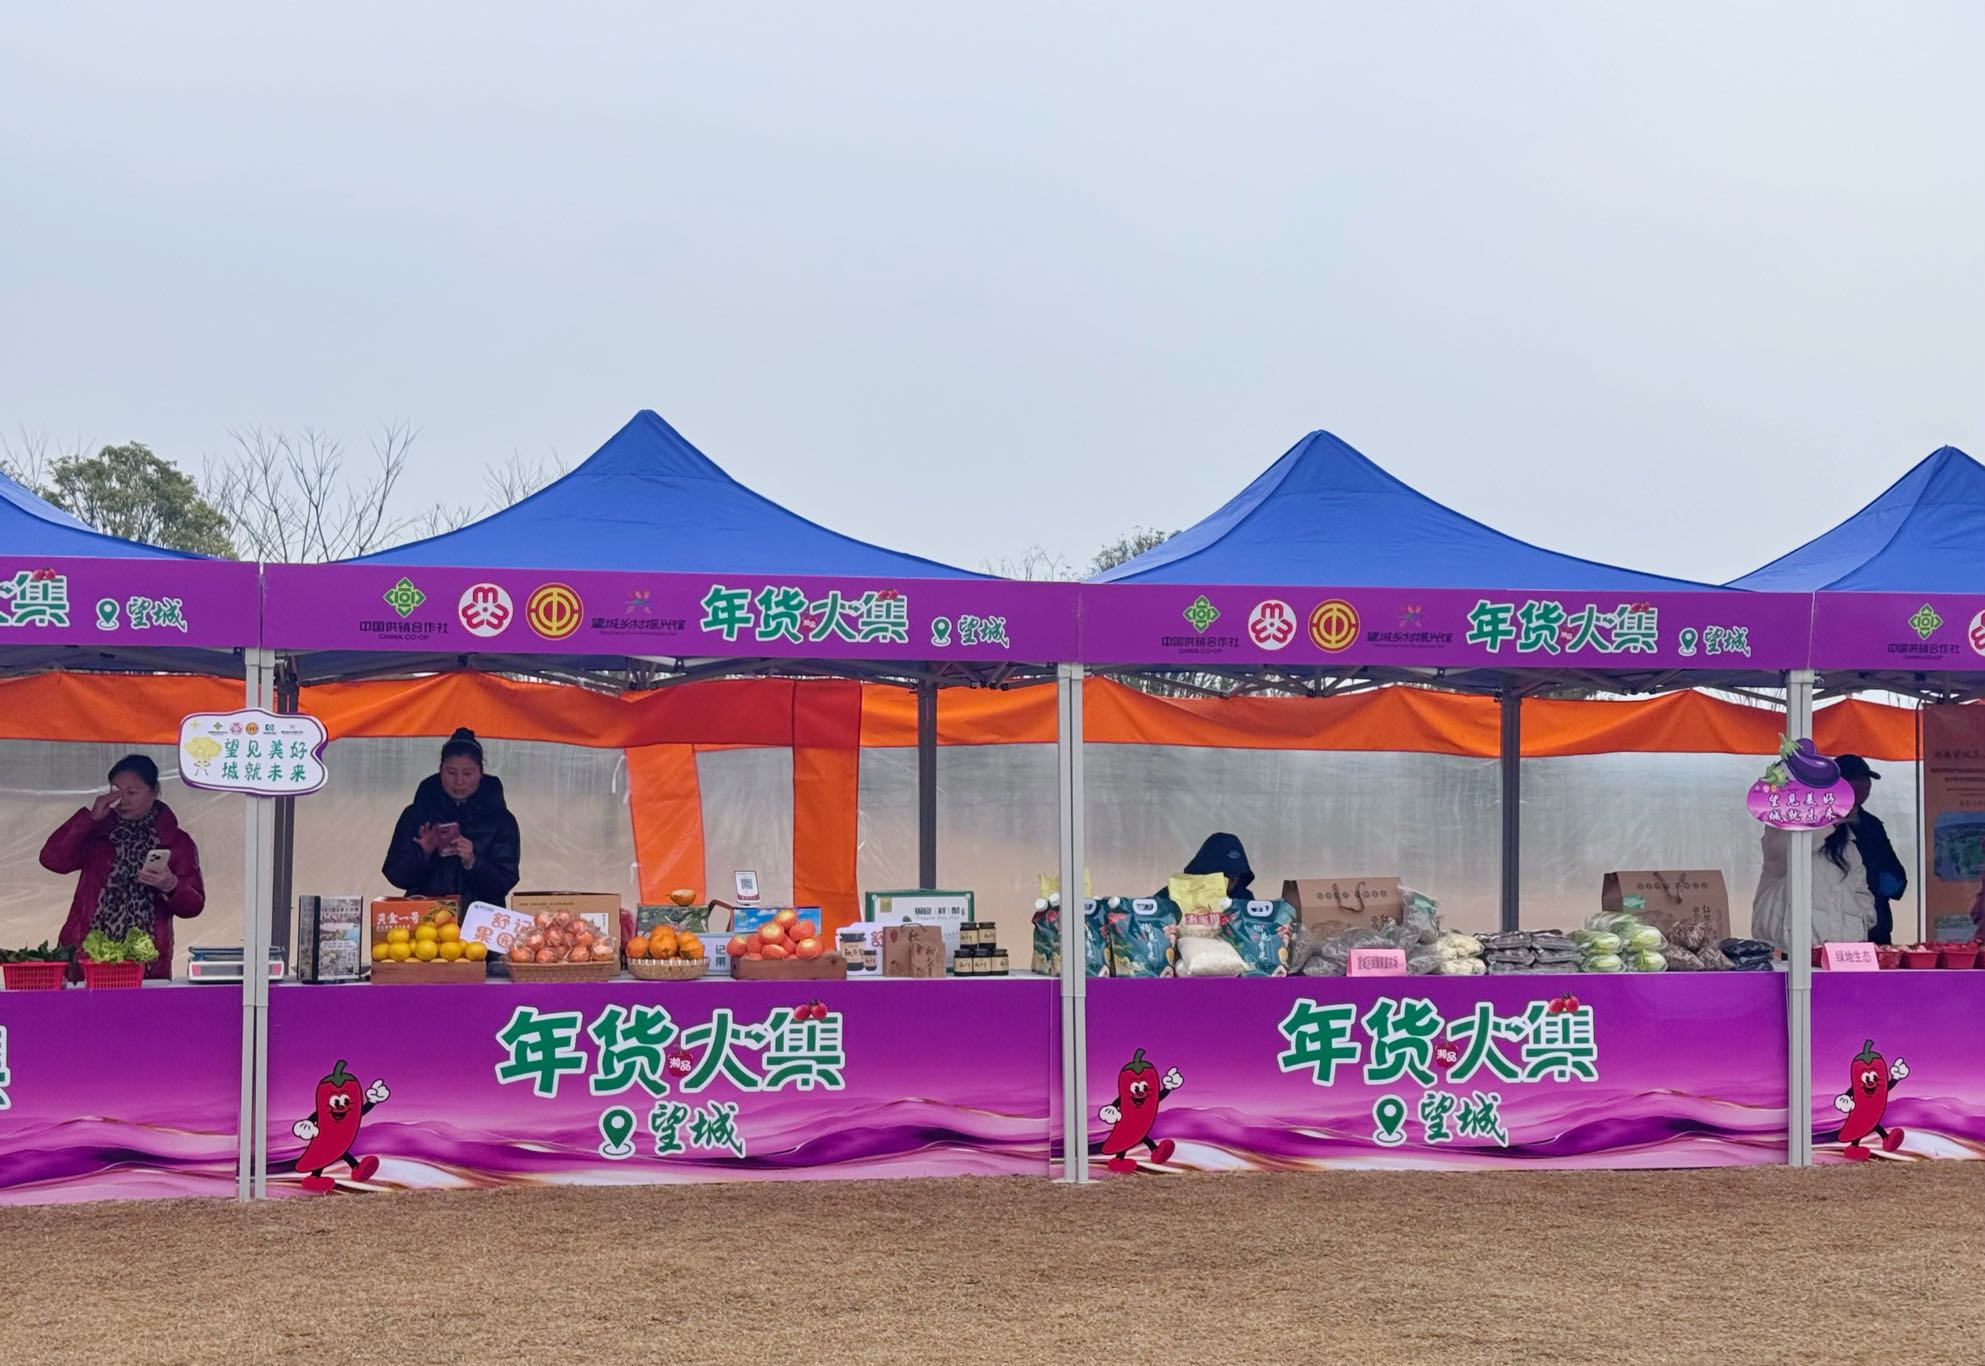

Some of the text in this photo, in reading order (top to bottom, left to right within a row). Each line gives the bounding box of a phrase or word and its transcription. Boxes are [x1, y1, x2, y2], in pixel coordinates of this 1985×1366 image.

[126, 595, 188, 633] 望城
[359, 620, 449, 634] 中国供销合作社
[698, 582, 910, 645] 年货大集
[957, 614, 1010, 648] 望城
[1465, 598, 1660, 656] 年货大集
[1701, 624, 1752, 658] 望城
[221, 761, 307, 783] 城就未来
[223, 737, 308, 760] 望见美好
[494, 1002, 846, 1098] 年货大集
[1276, 996, 1599, 1088] 年货大集
[647, 1099, 747, 1159] 望城
[1417, 1089, 1510, 1148] 望城
